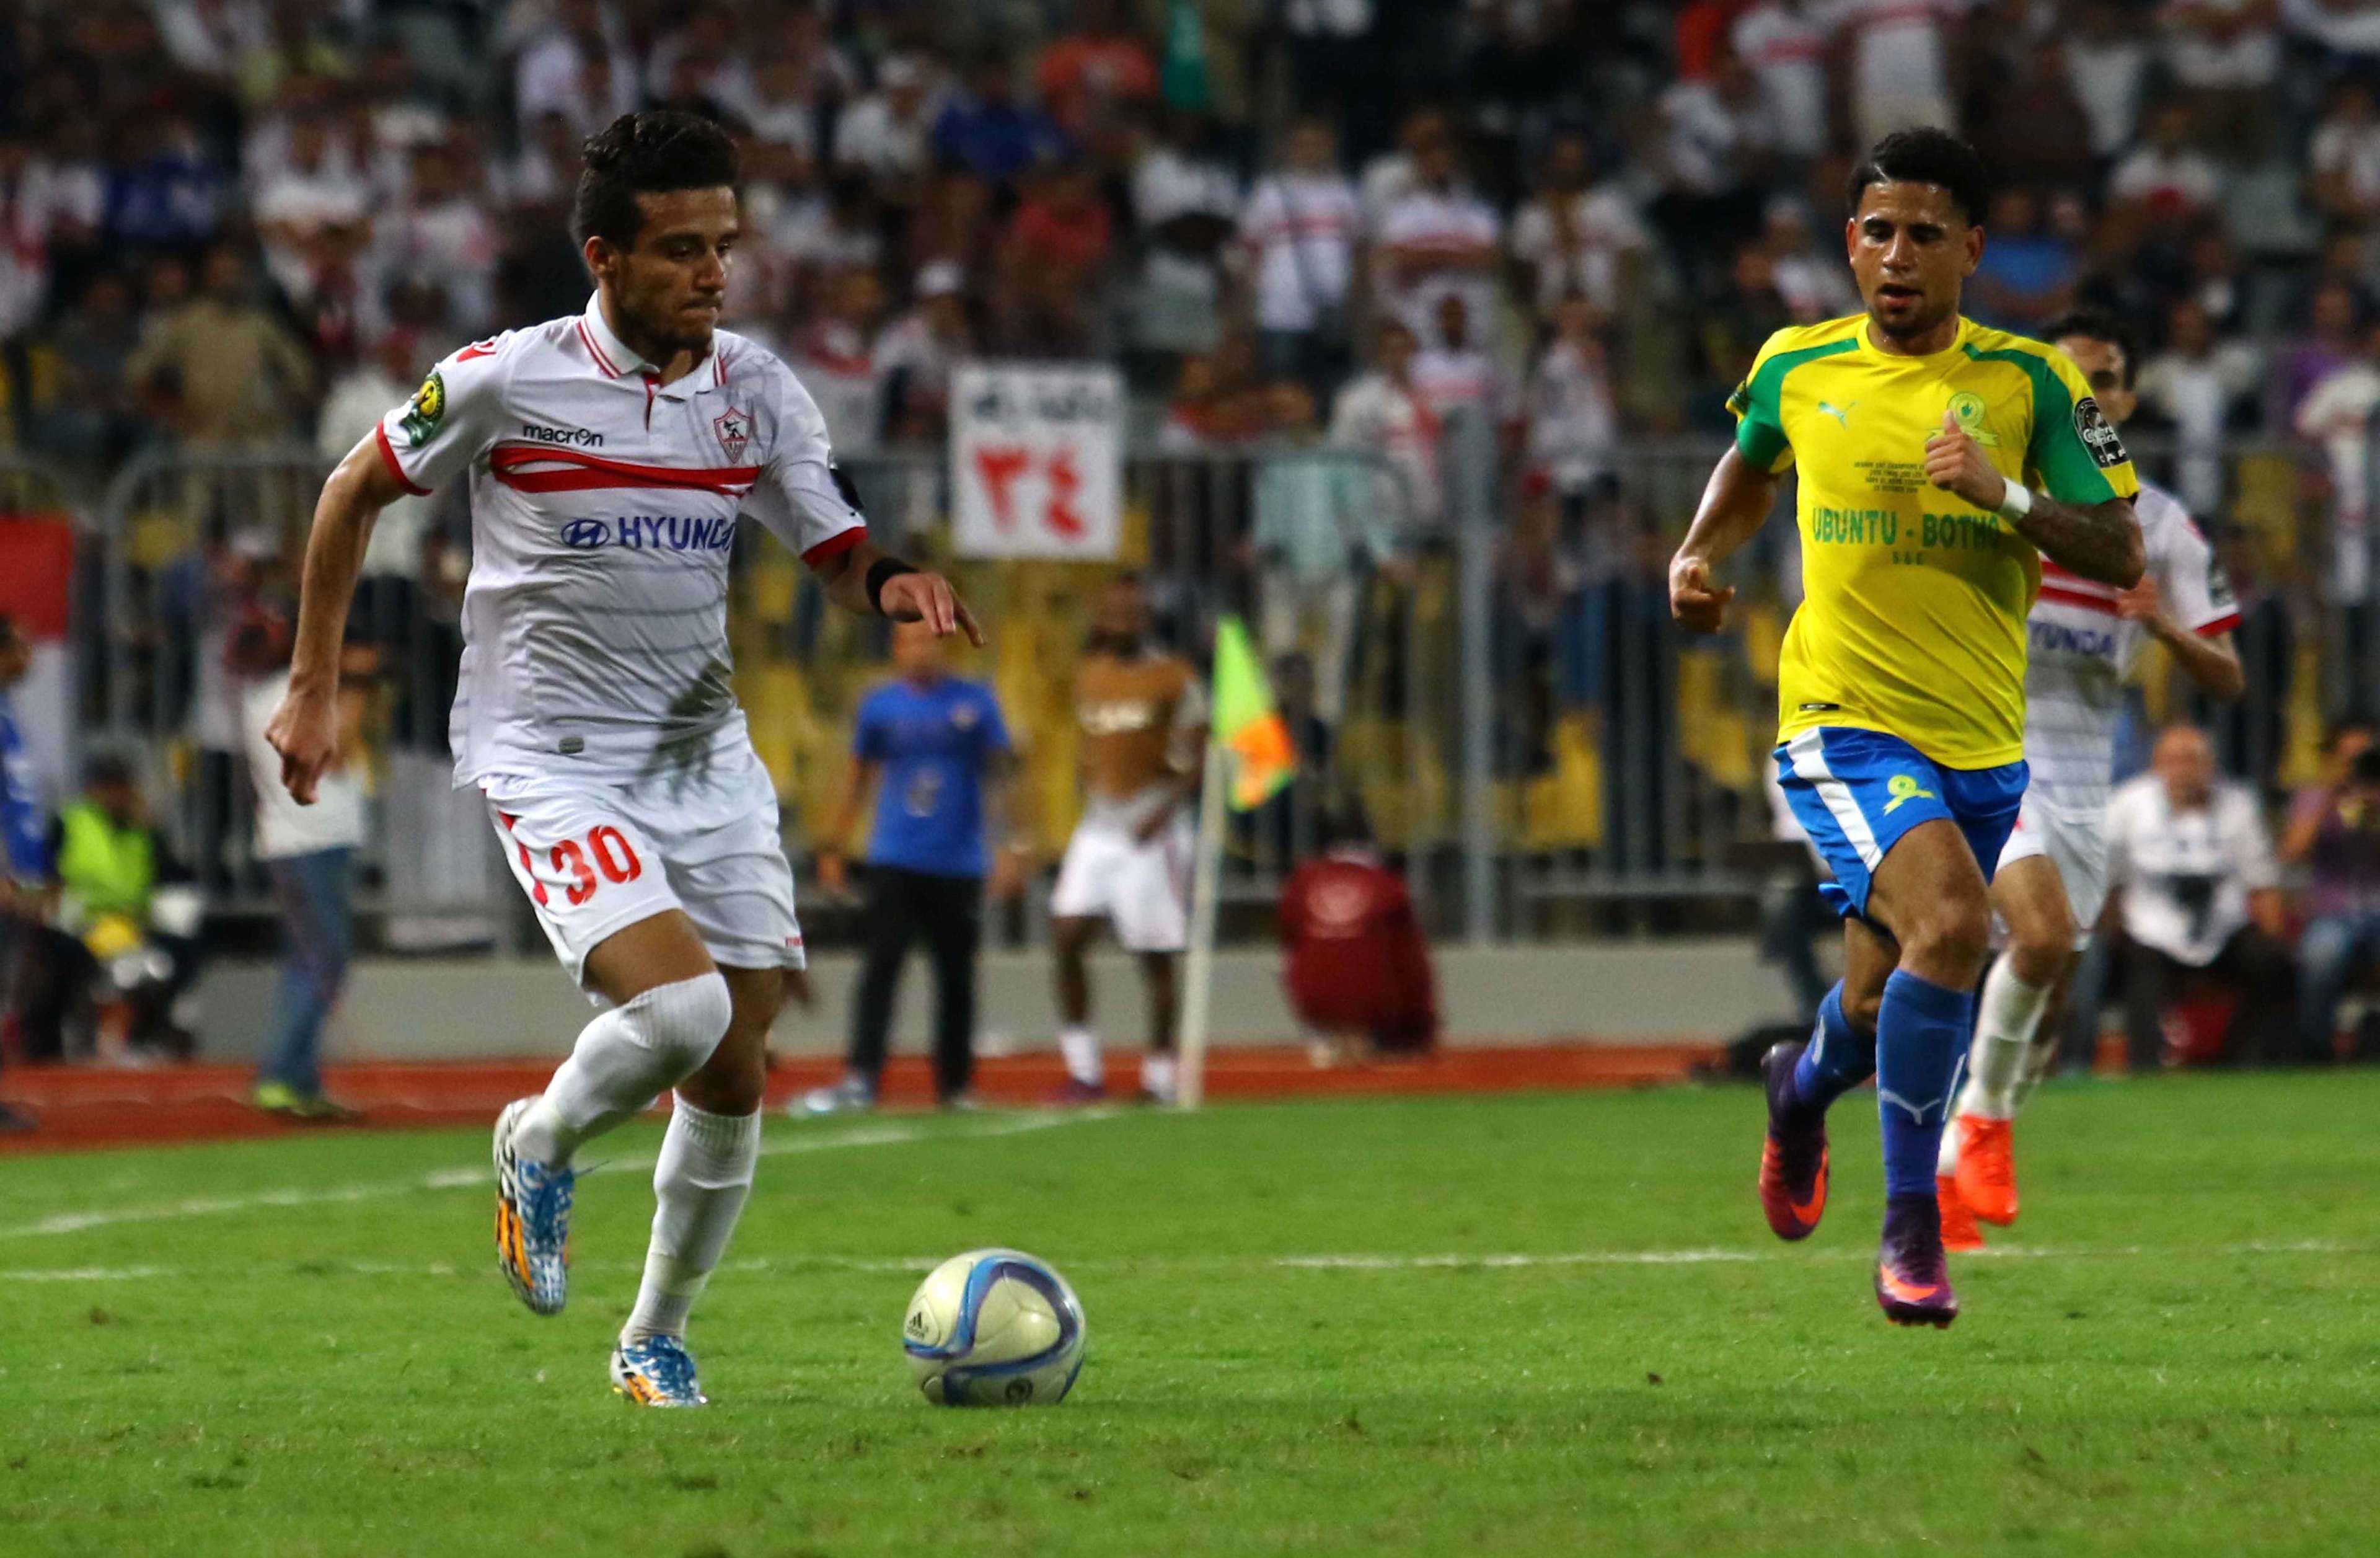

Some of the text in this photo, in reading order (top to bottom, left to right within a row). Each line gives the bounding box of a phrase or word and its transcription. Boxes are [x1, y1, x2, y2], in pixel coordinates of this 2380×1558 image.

[522, 425, 603, 446] macron
[1812, 508, 1897, 544] UBUNTU
[1923, 513, 2001, 550] BOTHO
[550, 825, 641, 906] 30
